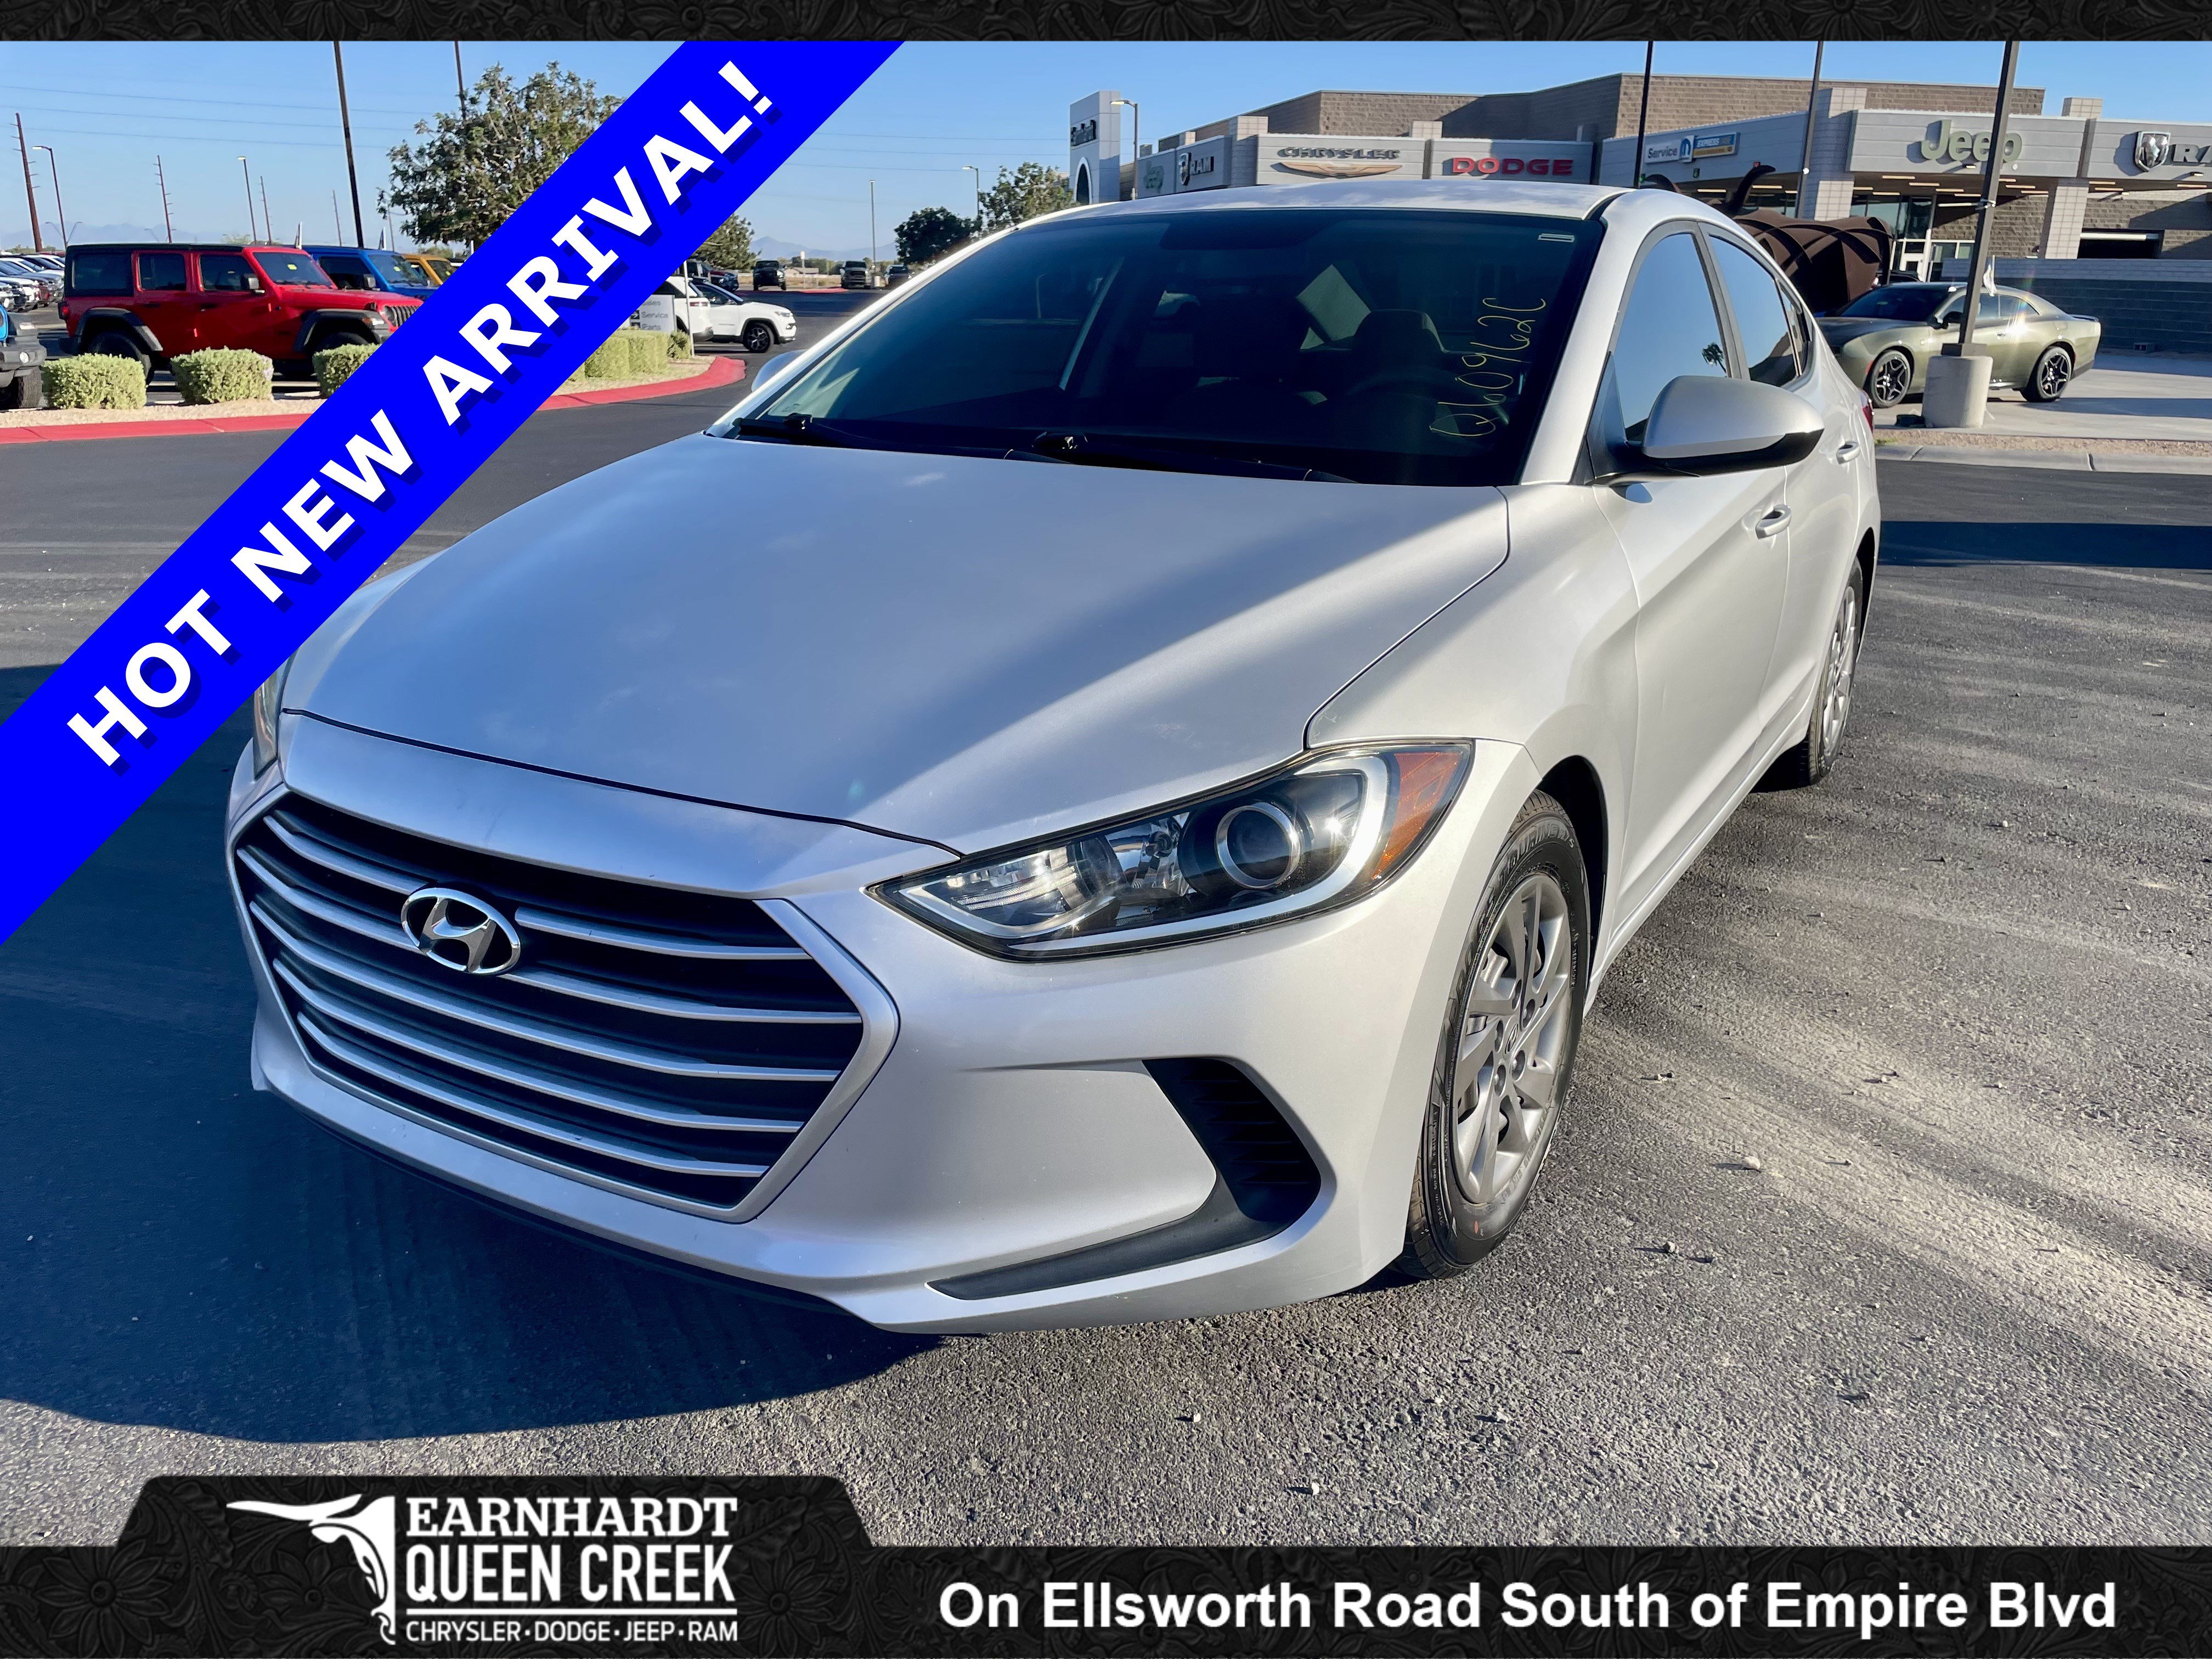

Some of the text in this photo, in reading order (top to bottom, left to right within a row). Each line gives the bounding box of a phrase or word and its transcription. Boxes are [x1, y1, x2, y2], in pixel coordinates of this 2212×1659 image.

[1283, 146, 1400, 159] CHRYSLER
[1647, 144, 1678, 159] Service
[1189, 156, 1214, 176] RAM
[1452, 156, 1573, 176] DODGE
